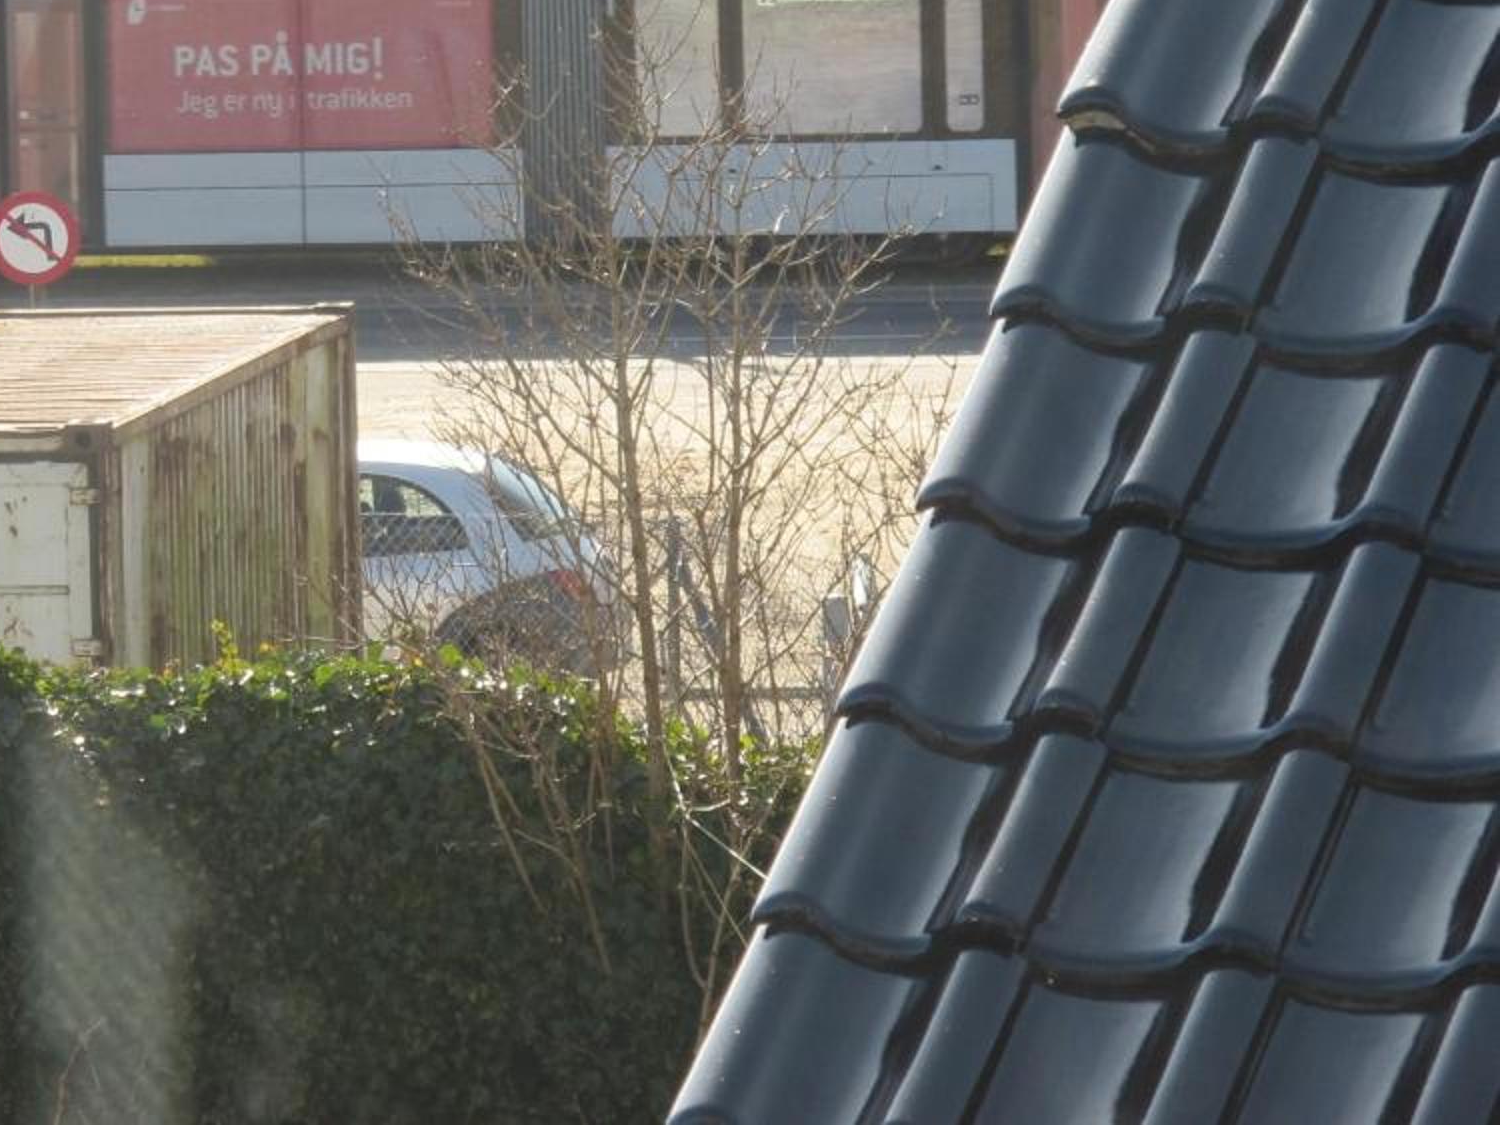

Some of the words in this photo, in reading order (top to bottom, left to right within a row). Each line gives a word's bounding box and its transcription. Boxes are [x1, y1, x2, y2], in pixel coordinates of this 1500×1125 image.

[173, 44, 240, 77] PAS
[250, 30, 294, 76] PÅ
[305, 36, 384, 79] MIG!
[176, 91, 219, 119] Jeg
[223, 92, 247, 114] er
[252, 93, 283, 118] ny
[307, 87, 413, 110] trafikken
